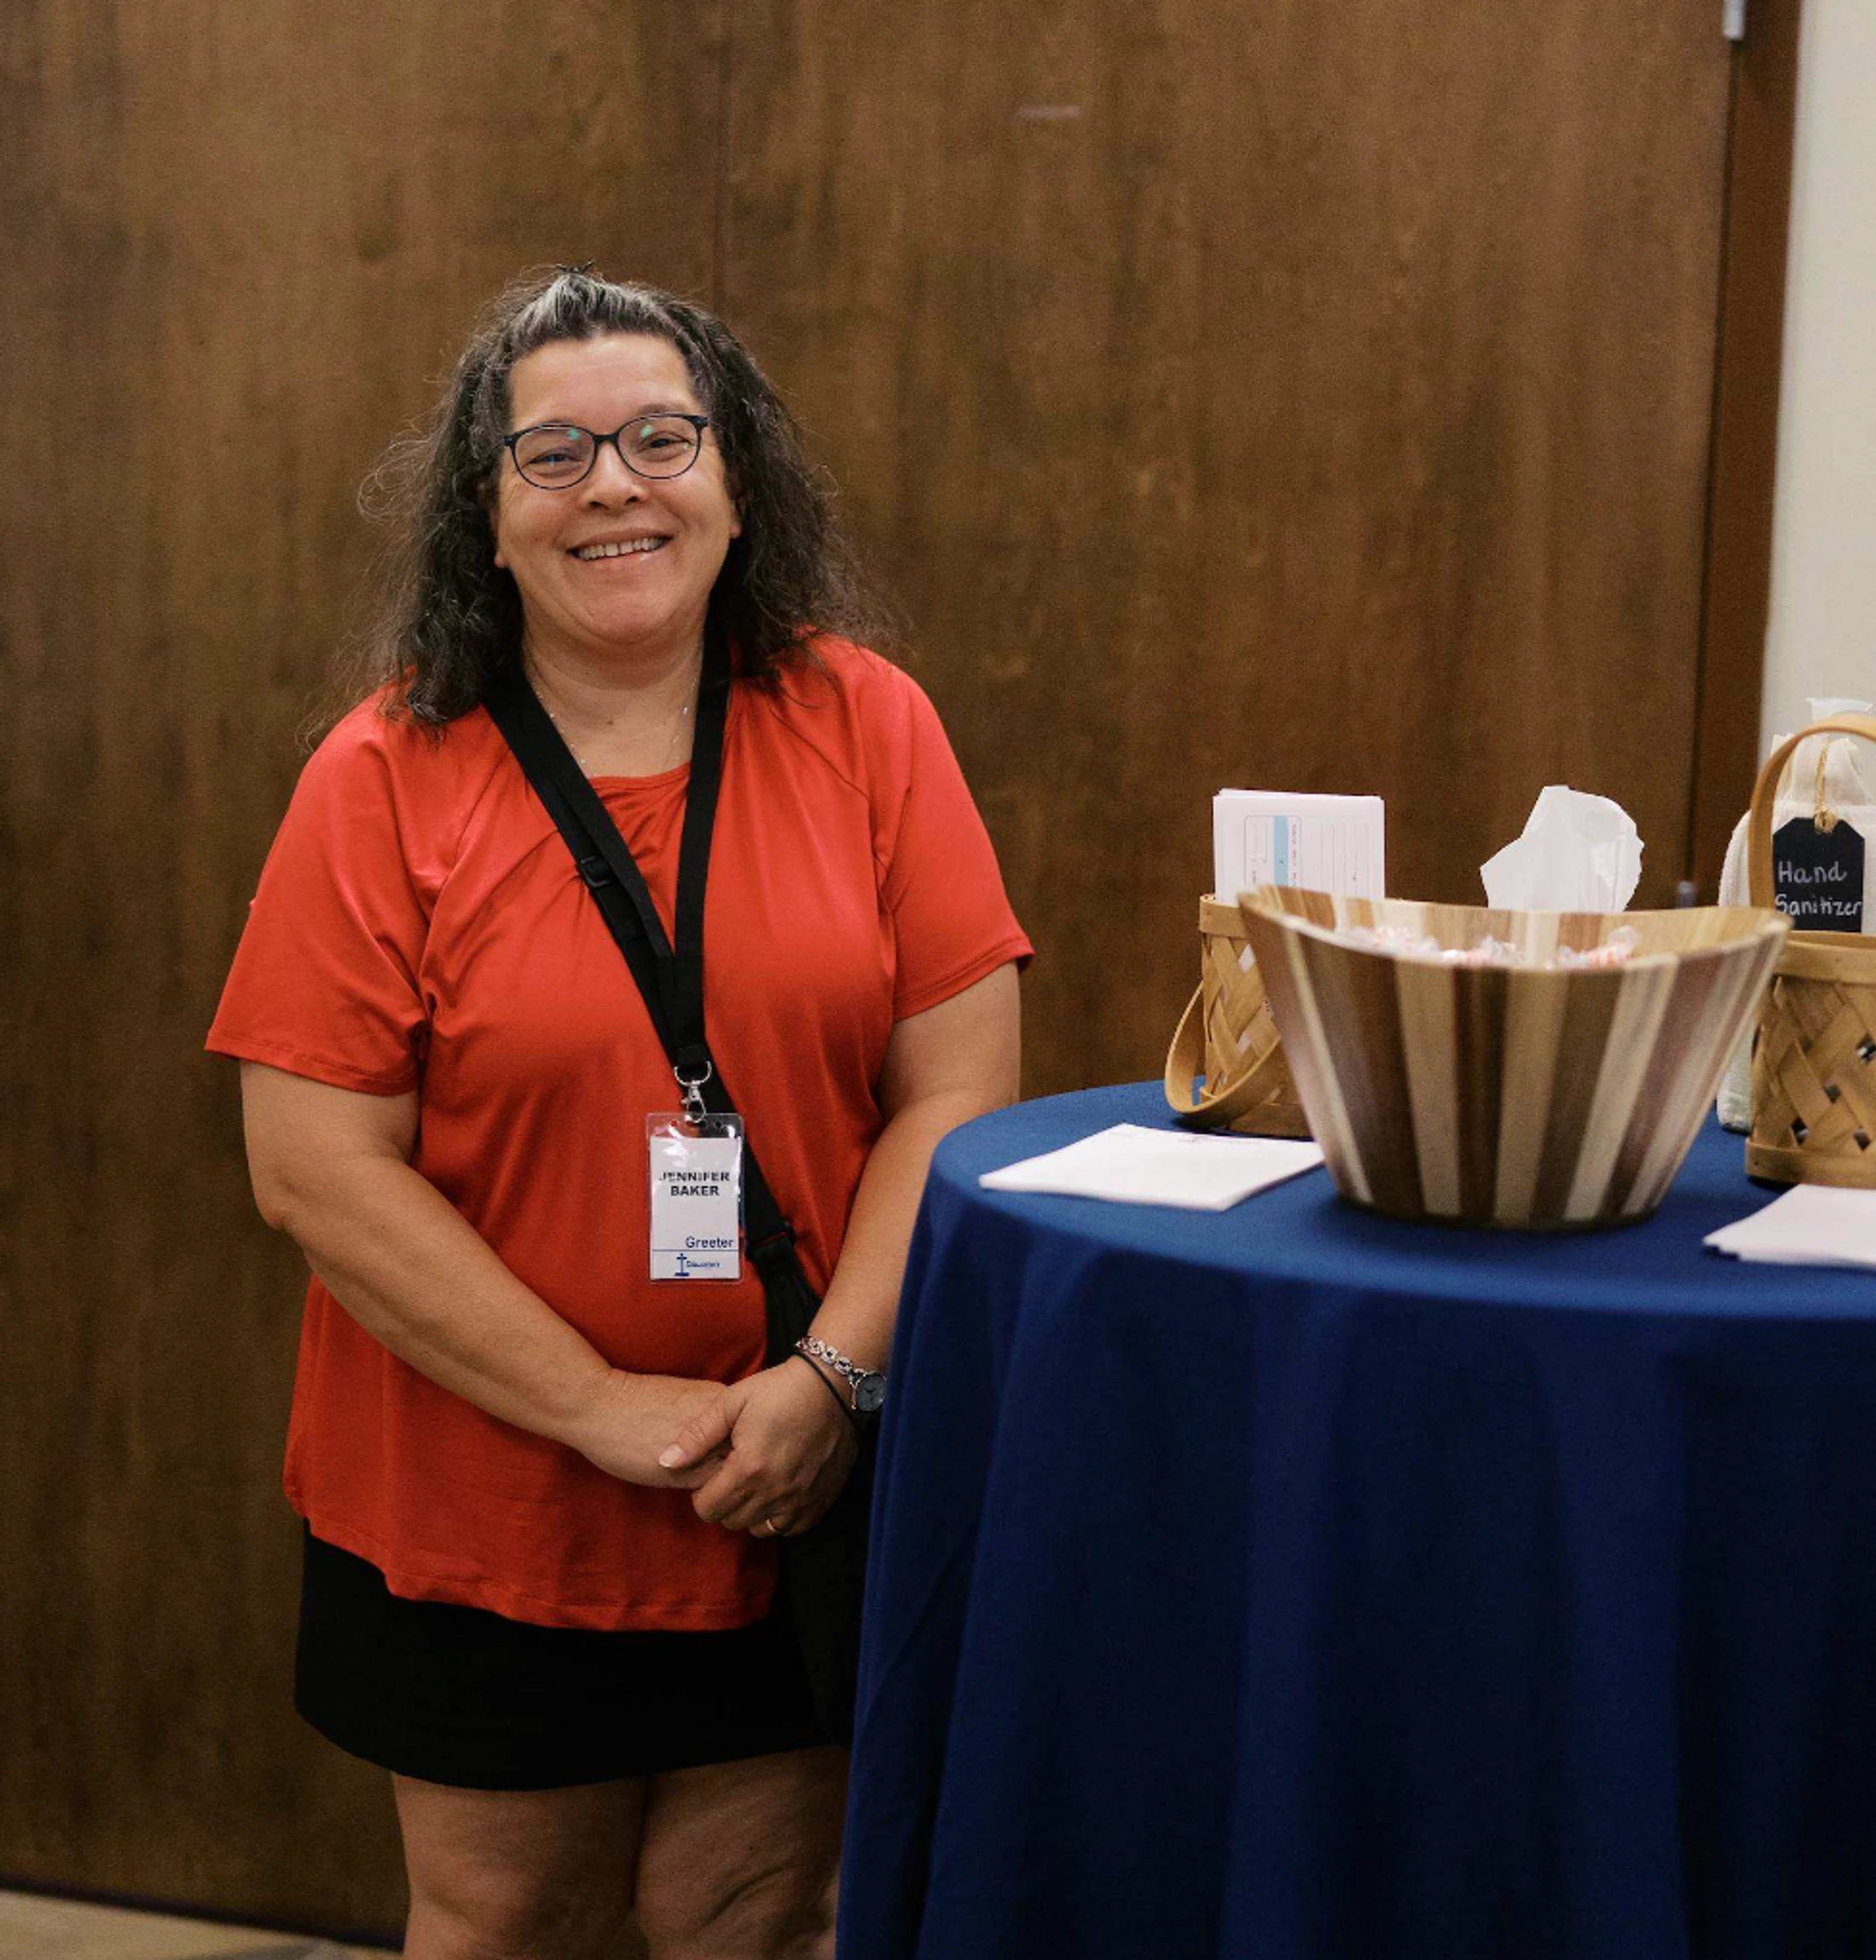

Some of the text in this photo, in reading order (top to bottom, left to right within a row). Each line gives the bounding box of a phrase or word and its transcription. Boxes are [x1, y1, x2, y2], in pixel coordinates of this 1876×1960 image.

[1778, 860, 1848, 883] Hand
[1775, 893, 1862, 916] Sanitizer
[659, 1171, 730, 1182] JENNIFER
[670, 1186, 720, 1196] BAKER
[686, 1235, 734, 1248] Greeter
